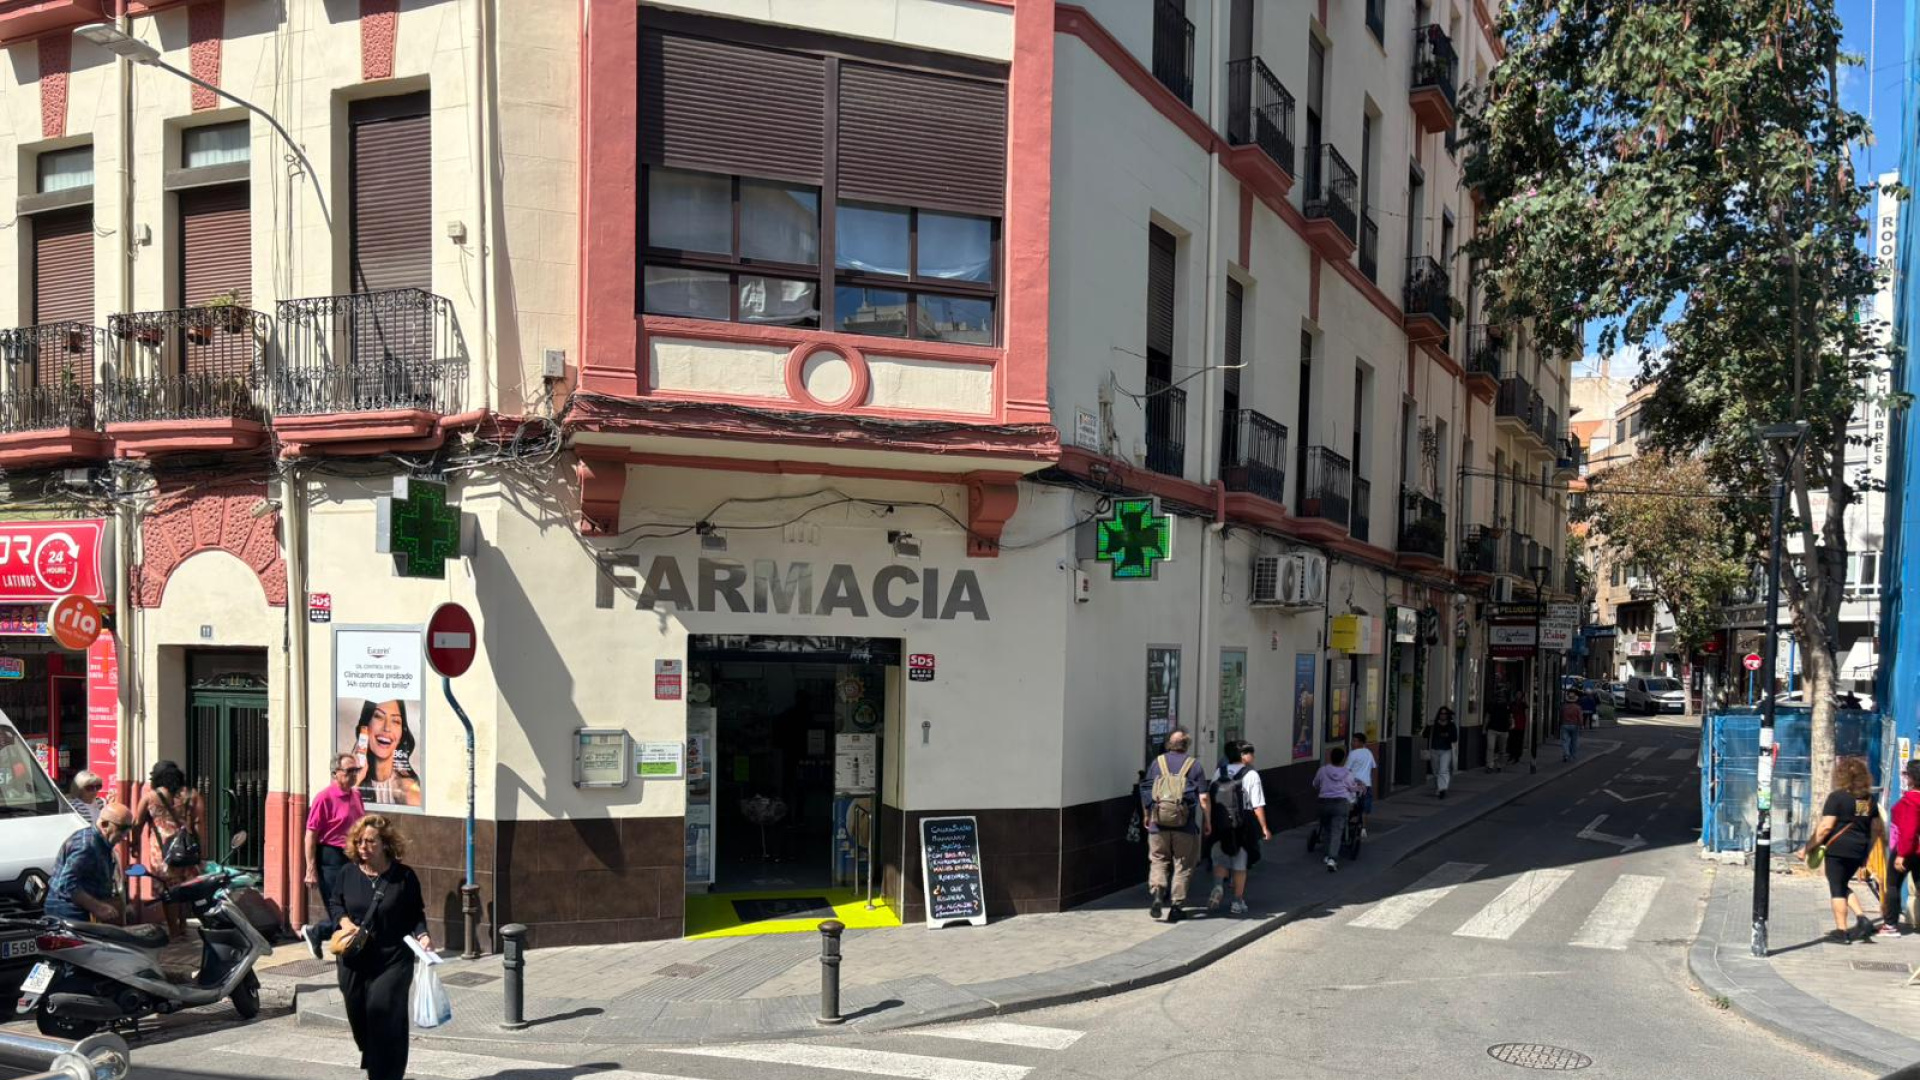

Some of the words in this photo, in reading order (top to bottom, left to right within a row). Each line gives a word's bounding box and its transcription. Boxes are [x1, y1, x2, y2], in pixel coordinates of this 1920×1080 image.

[48, 551, 64, 564] 24
[2, 574, 37, 588] LATINOS
[596, 554, 991, 621] FARMACIA
[59, 602, 97, 635] ria
[910, 655, 933, 668] SDS
